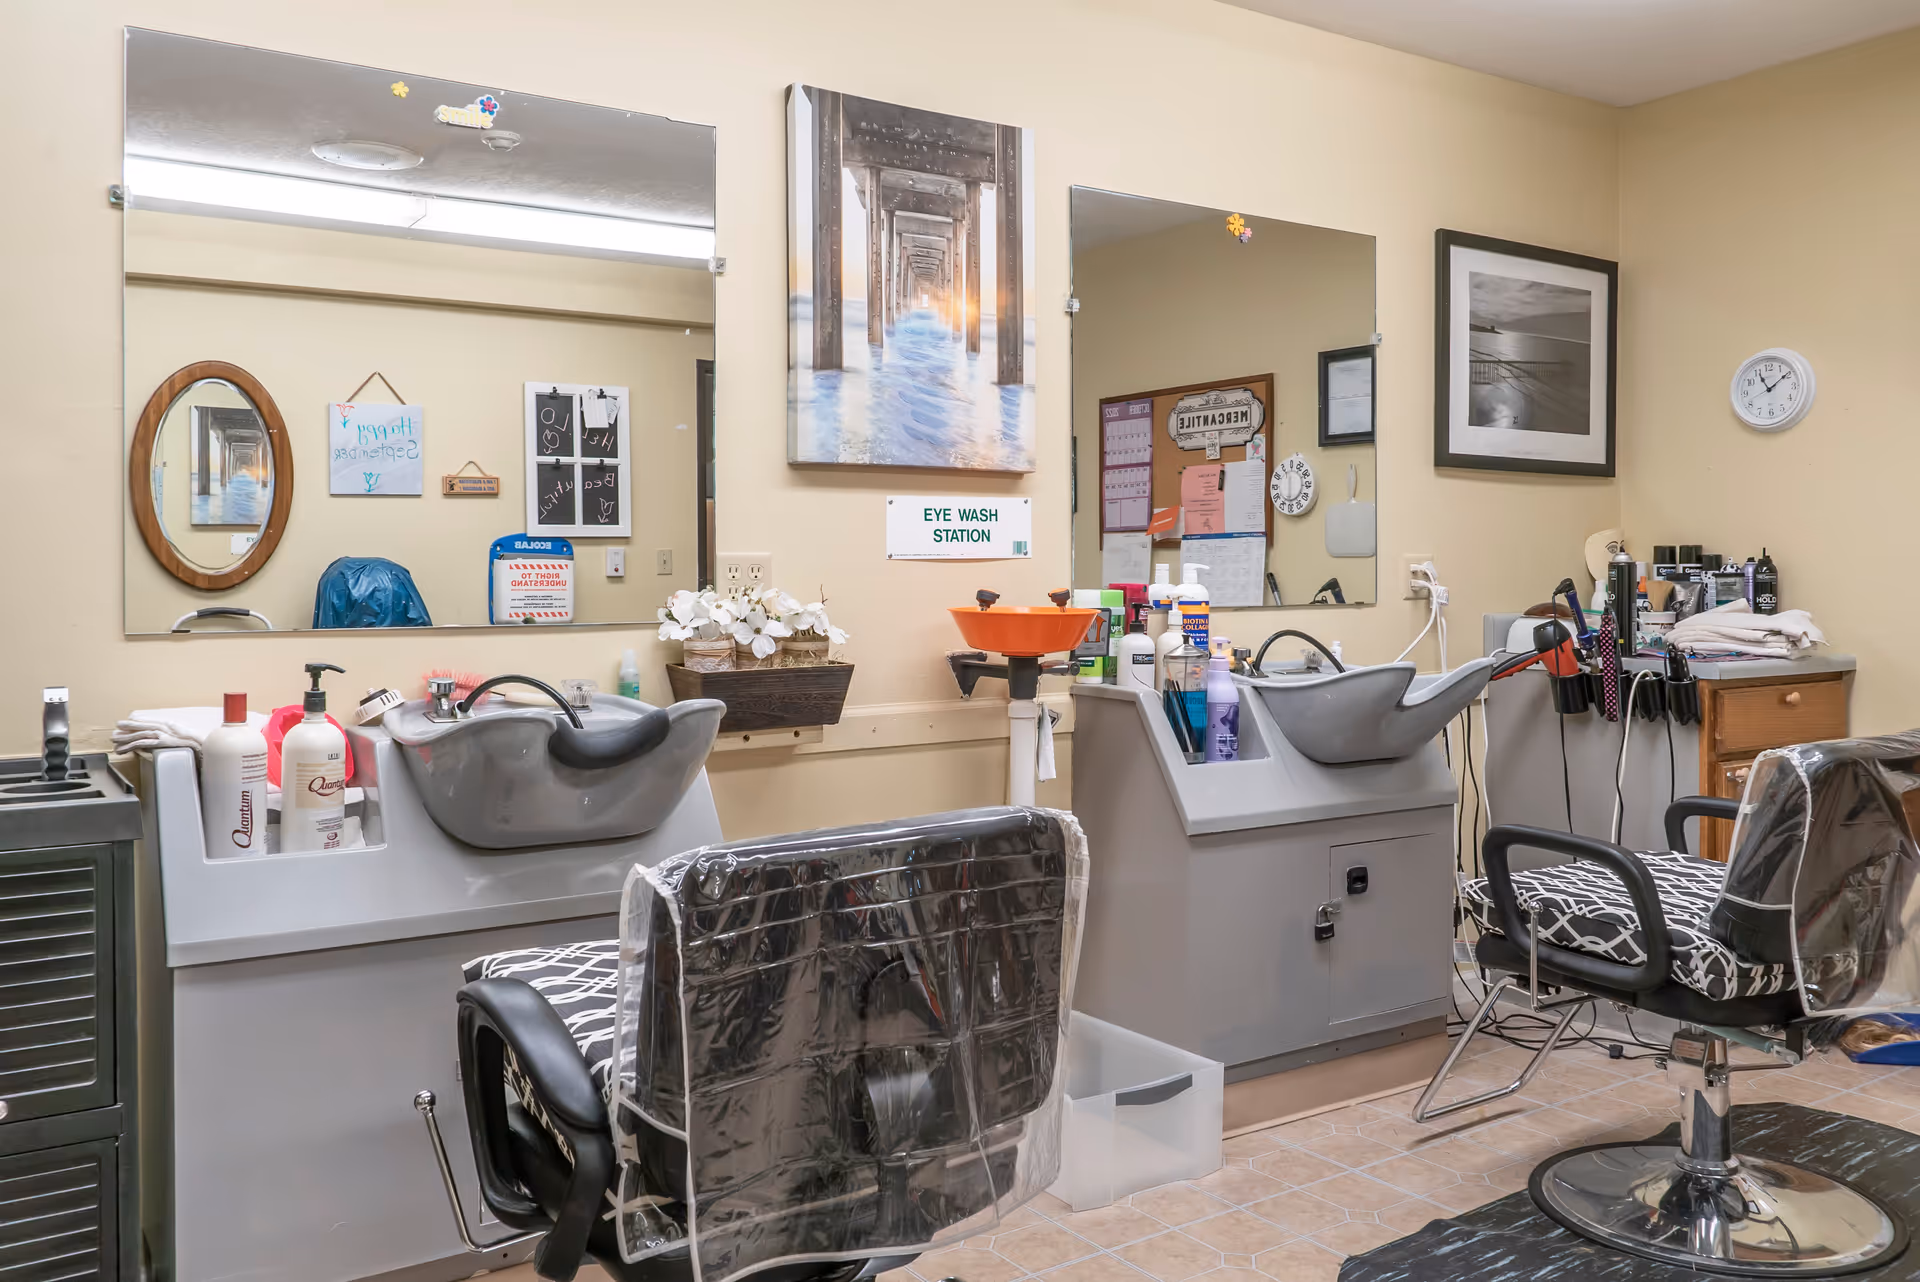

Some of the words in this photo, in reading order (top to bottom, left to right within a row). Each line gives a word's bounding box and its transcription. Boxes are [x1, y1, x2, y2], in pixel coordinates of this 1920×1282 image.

[439, 105, 493, 128] smile
[1764, 363, 1773, 372] 12
[1786, 371, 1792, 379] 2
[1747, 378, 1755, 386] 10
[1791, 382, 1796, 390] 3
[1756, 408, 1762, 416] 7
[1768, 408, 1774, 416] 6
[1780, 404, 1785, 412] 5
[924, 508, 952, 522] EYE
[958, 508, 998, 522] WASH
[934, 528, 990, 542] STATION
[232, 790, 253, 849] Quantum
